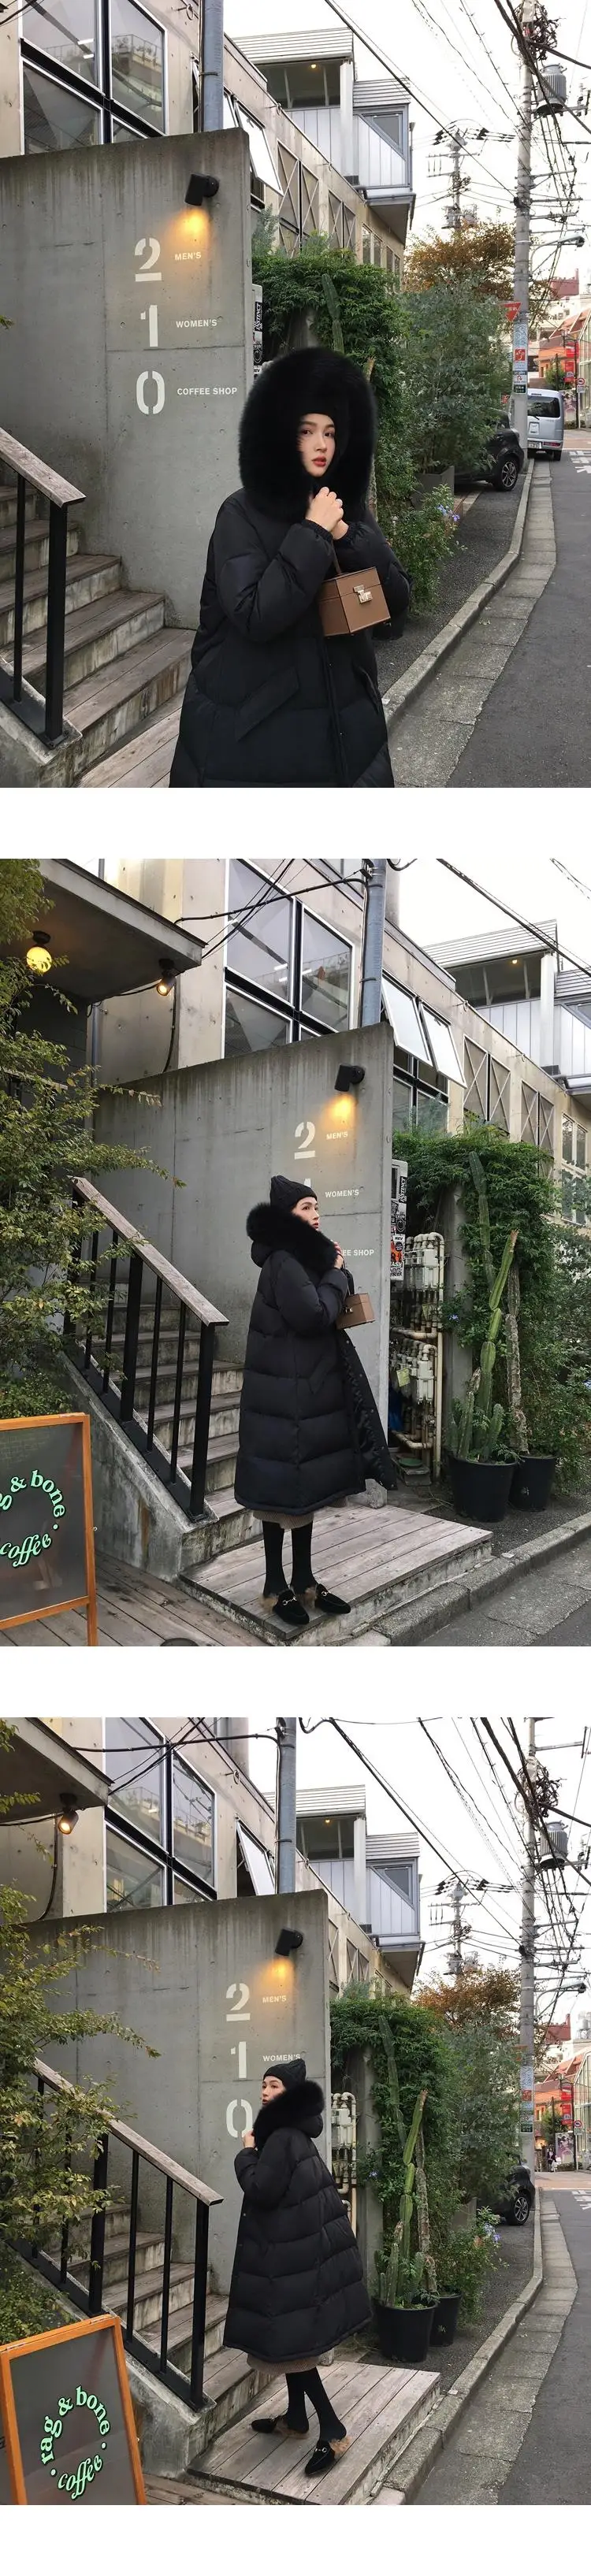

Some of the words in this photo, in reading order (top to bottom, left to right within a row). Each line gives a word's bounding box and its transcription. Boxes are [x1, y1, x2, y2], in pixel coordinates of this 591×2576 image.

[135, 238, 162, 281] 2
[175, 252, 202, 261] MEN'S
[141, 305, 158, 347] 1
[176, 319, 217, 328] WOMEN'S
[295, 1122, 315, 1160] 2
[326, 1131, 348, 1140] MEN'S
[325, 1190, 359, 1198] WOMEN'S
[10, 1476, 26, 1492] &
[31, 1470, 65, 1517] bone
[0, 1534, 51, 1567] coffee
[226, 1984, 250, 2021] 2
[231, 2042, 247, 2078] 1
[41, 2416, 62, 2464] rag
[58, 2398, 72, 2416] &
[76, 2386, 110, 2434] bone
[58, 2455, 102, 2499] coffee
